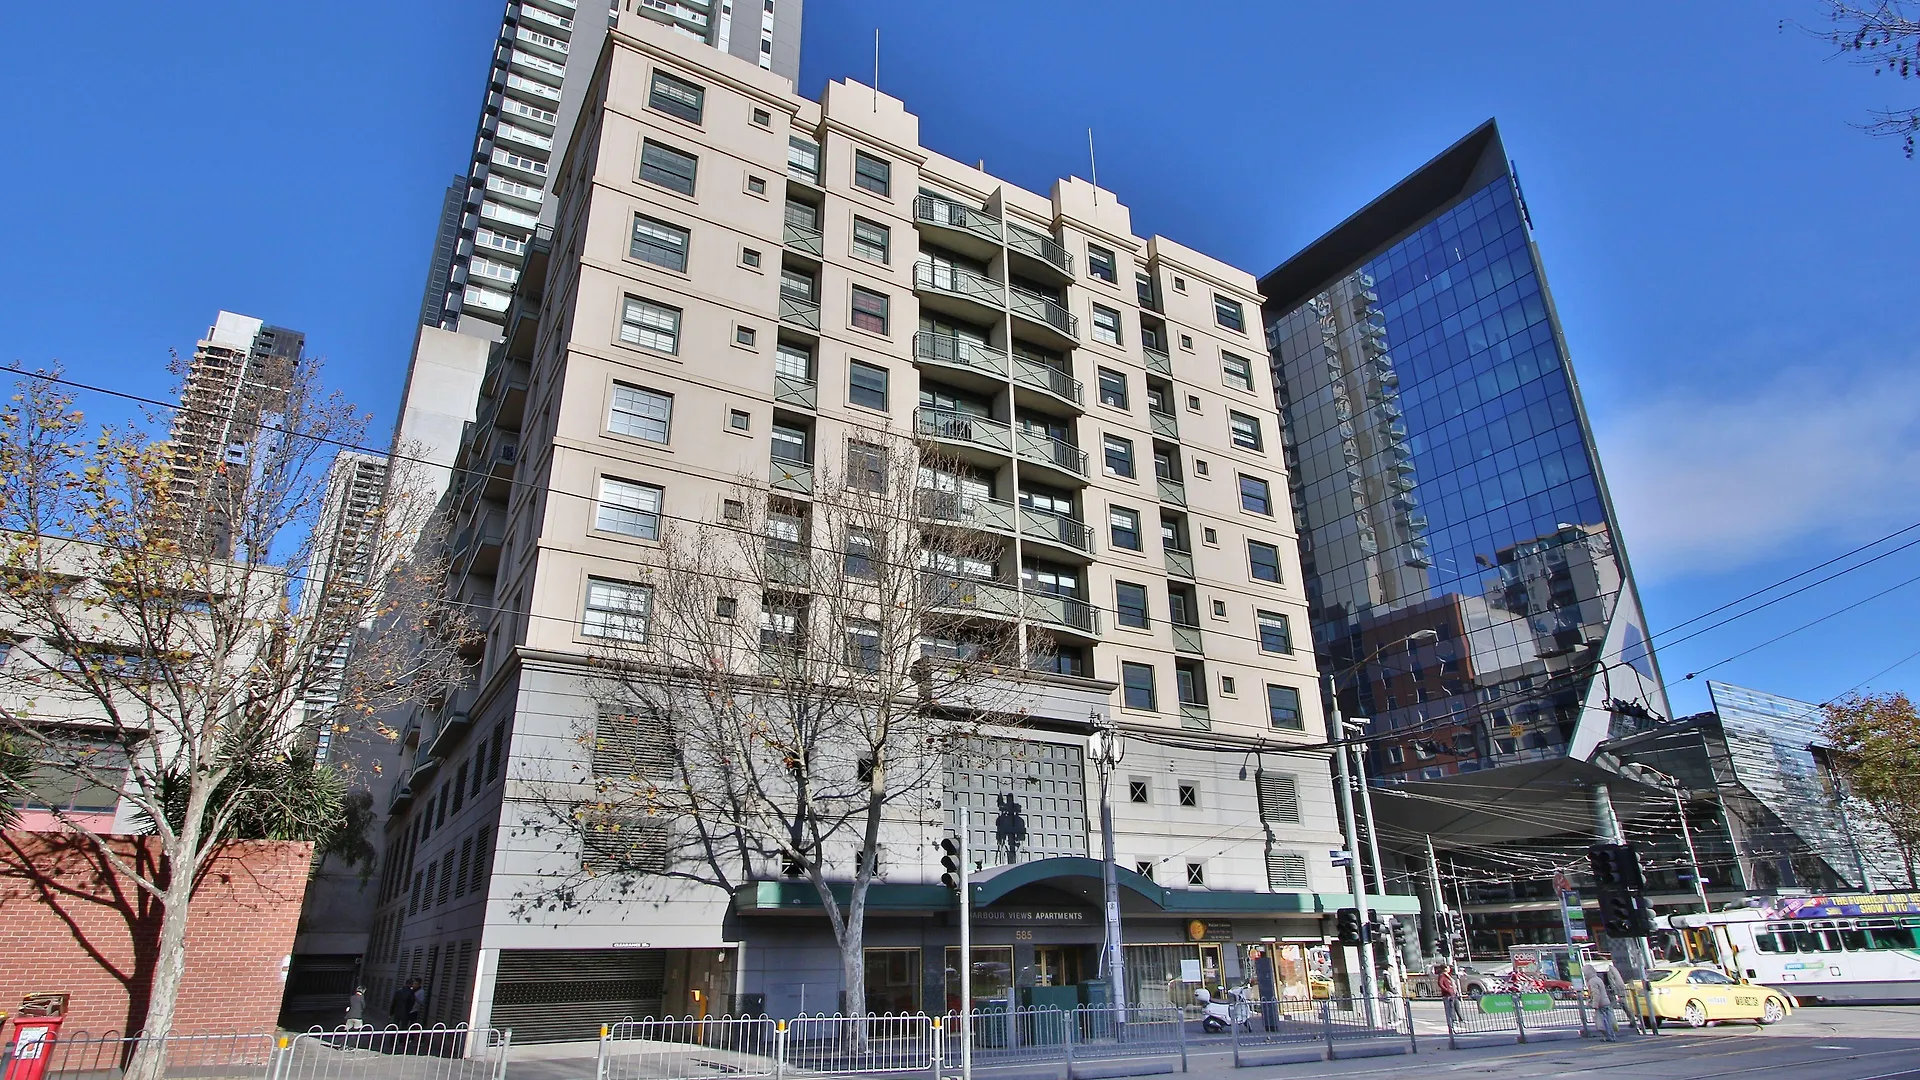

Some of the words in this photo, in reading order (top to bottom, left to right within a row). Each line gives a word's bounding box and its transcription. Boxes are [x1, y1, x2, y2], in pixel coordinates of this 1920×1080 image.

[1829, 896, 1848, 905] THE
[1890, 893, 1908, 903] AND
[1860, 904, 1885, 913] SHOW
[1885, 903, 1897, 912] IN
[1008, 911, 1032, 919] VIEWS
[1016, 930, 1032, 940] 585
